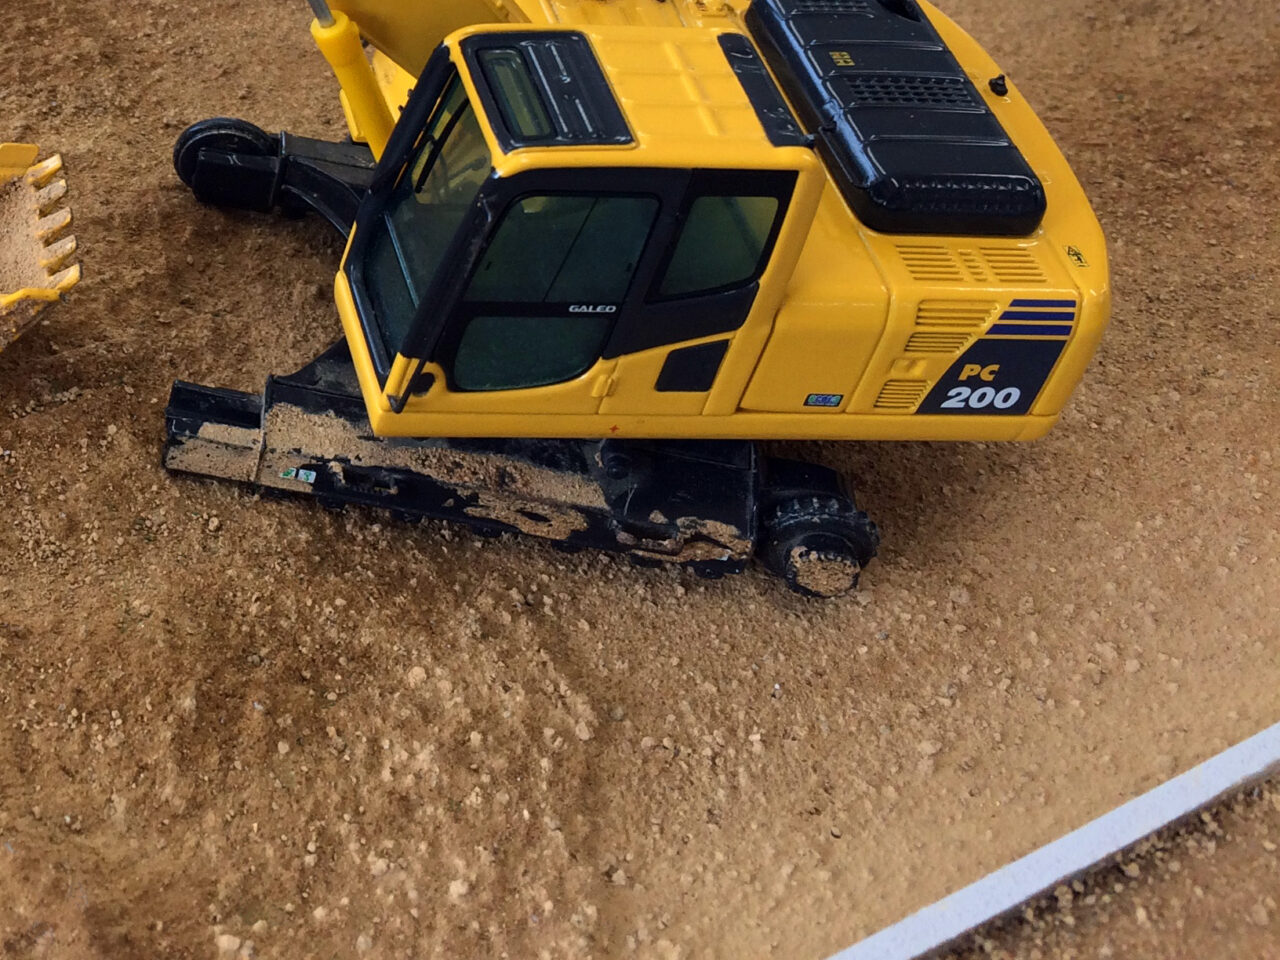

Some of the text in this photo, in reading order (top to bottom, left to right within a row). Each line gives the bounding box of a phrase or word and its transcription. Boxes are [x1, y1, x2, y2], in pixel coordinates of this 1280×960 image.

[568, 304, 617, 313] GALEO
[958, 364, 1000, 381] PC
[940, 386, 1021, 409] 200
